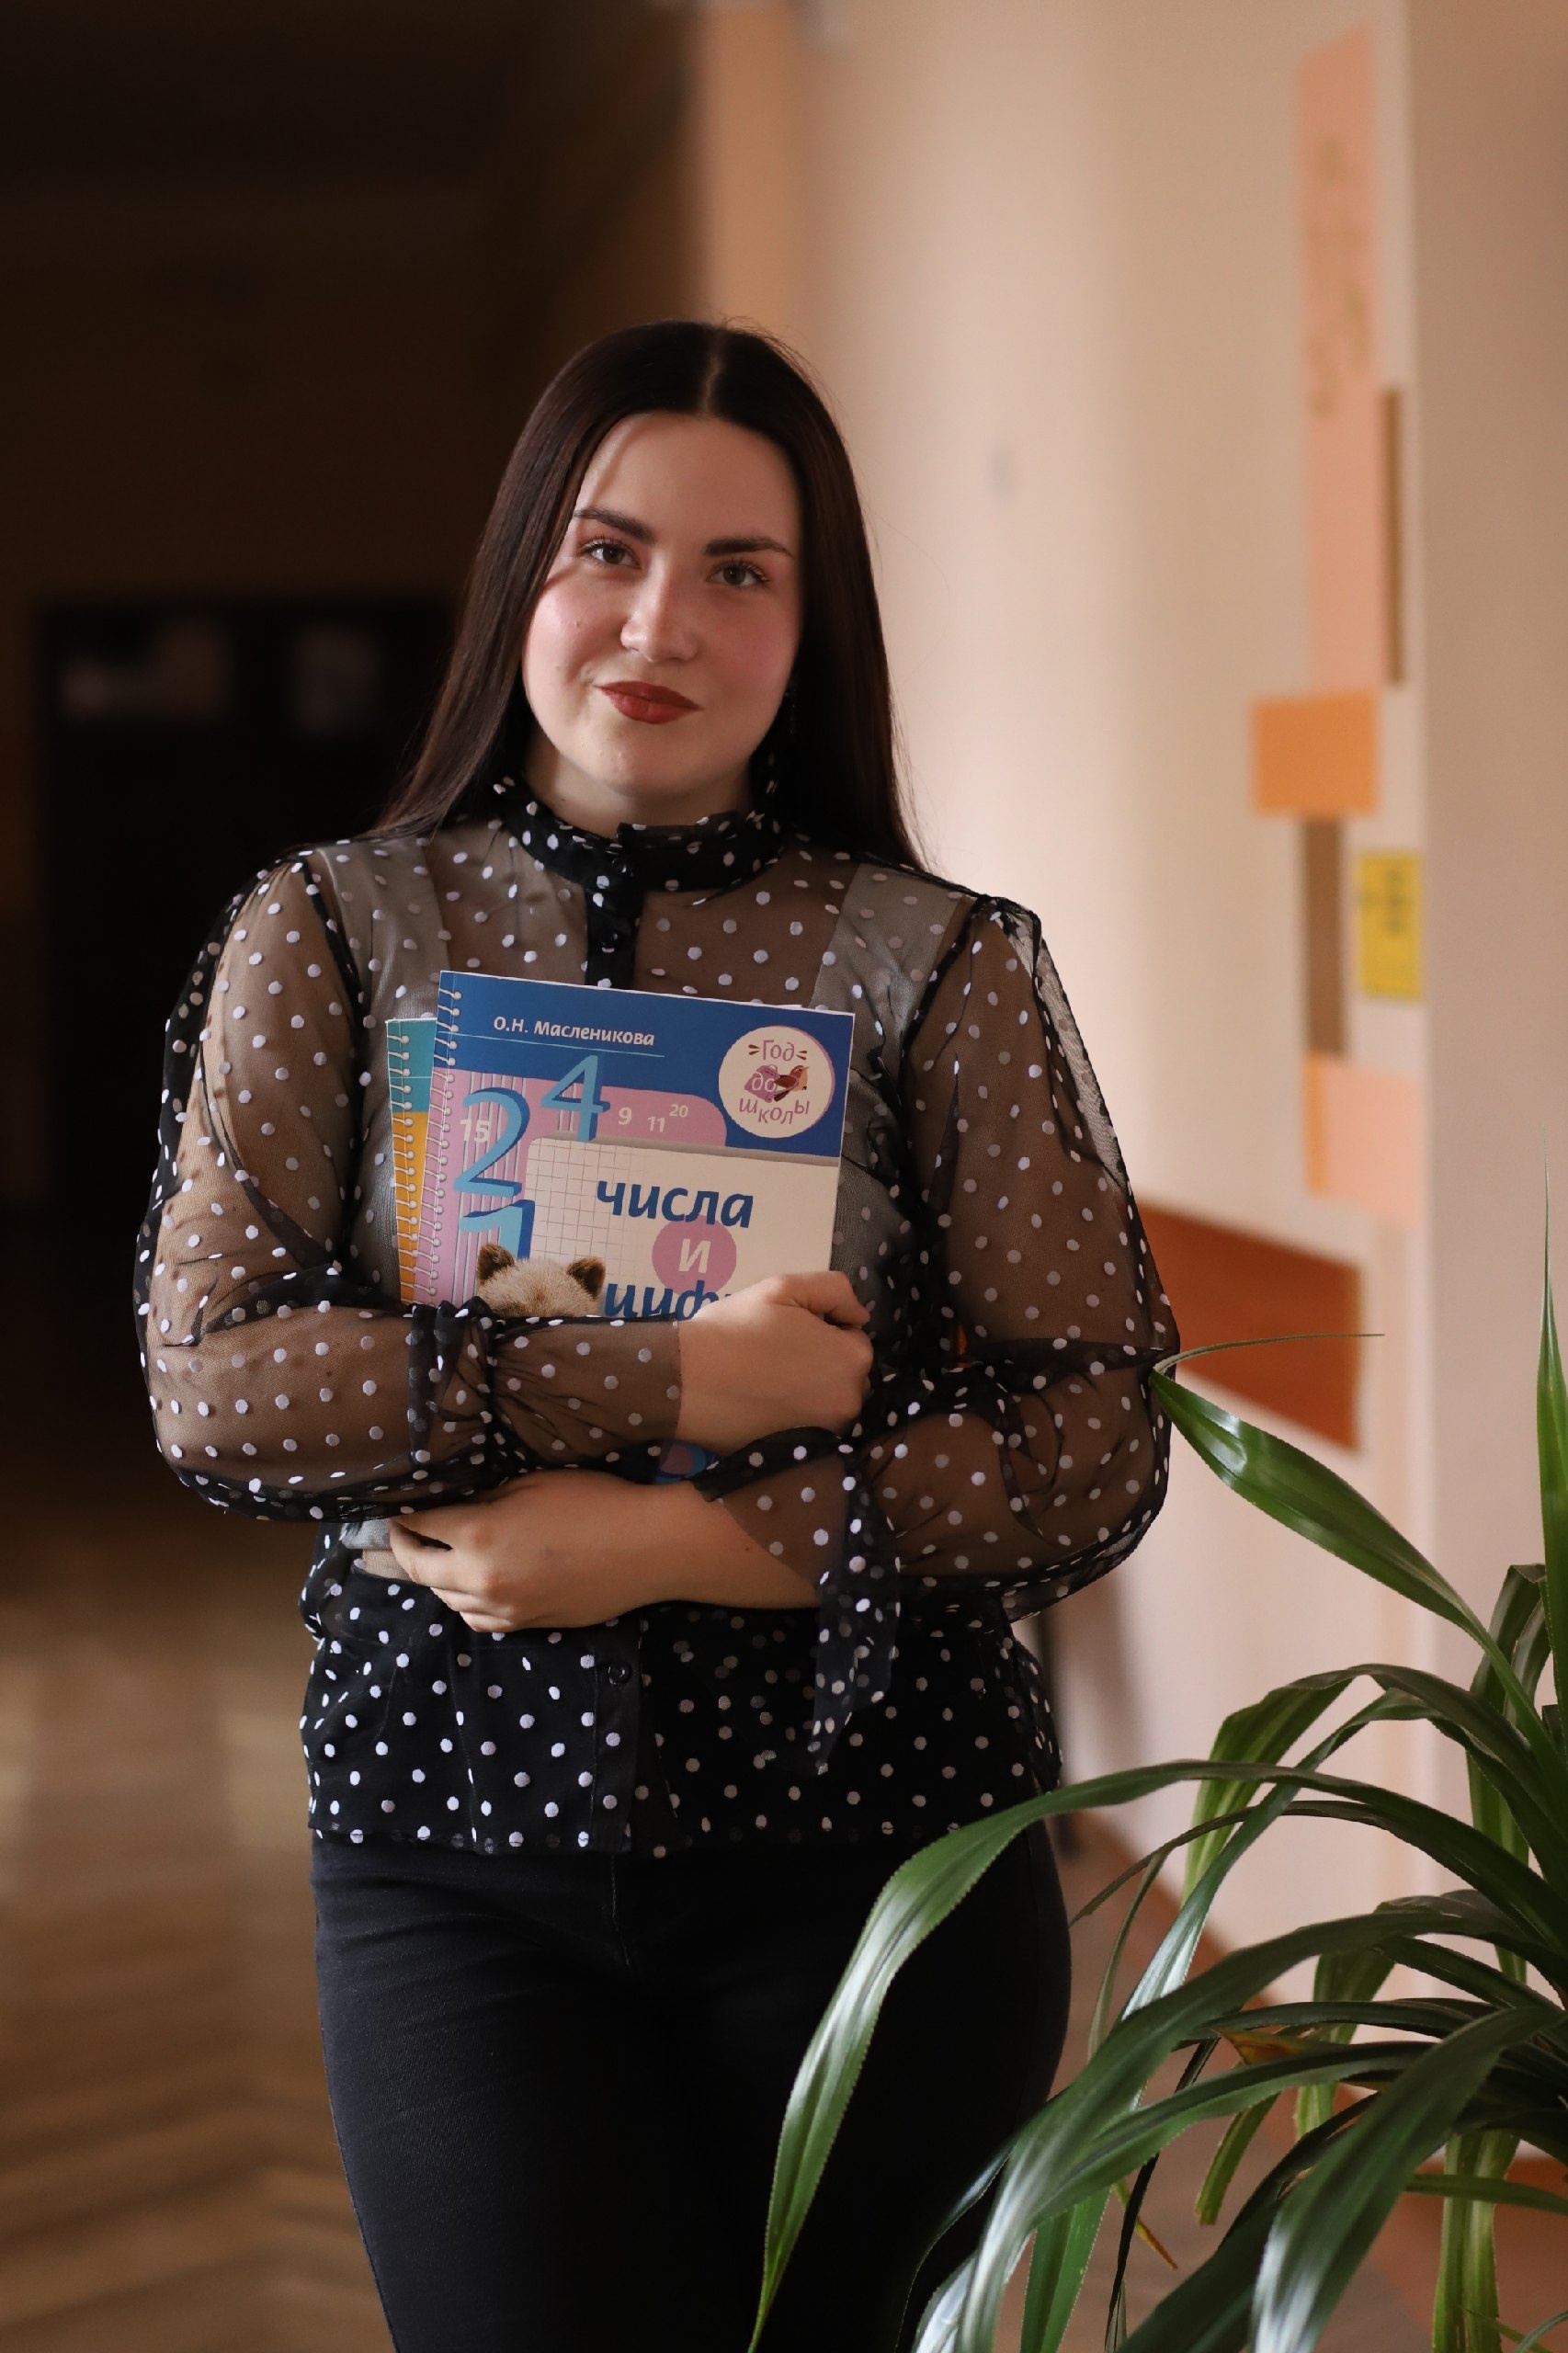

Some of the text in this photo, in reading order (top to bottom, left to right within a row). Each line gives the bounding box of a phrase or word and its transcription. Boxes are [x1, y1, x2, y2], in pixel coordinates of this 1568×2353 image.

[494, 1016, 655, 1046] О.Н. Масленикова
[762, 1040, 795, 1062] Год
[540, 1055, 610, 1142] 4
[669, 1104, 689, 1119] 20
[738, 1097, 810, 1125] школы
[618, 1107, 632, 1126] 9
[647, 1115, 665, 1133] 11
[454, 1087, 530, 1197] 2
[460, 1118, 493, 1143] 15
[604, 1279, 733, 1321] циф
